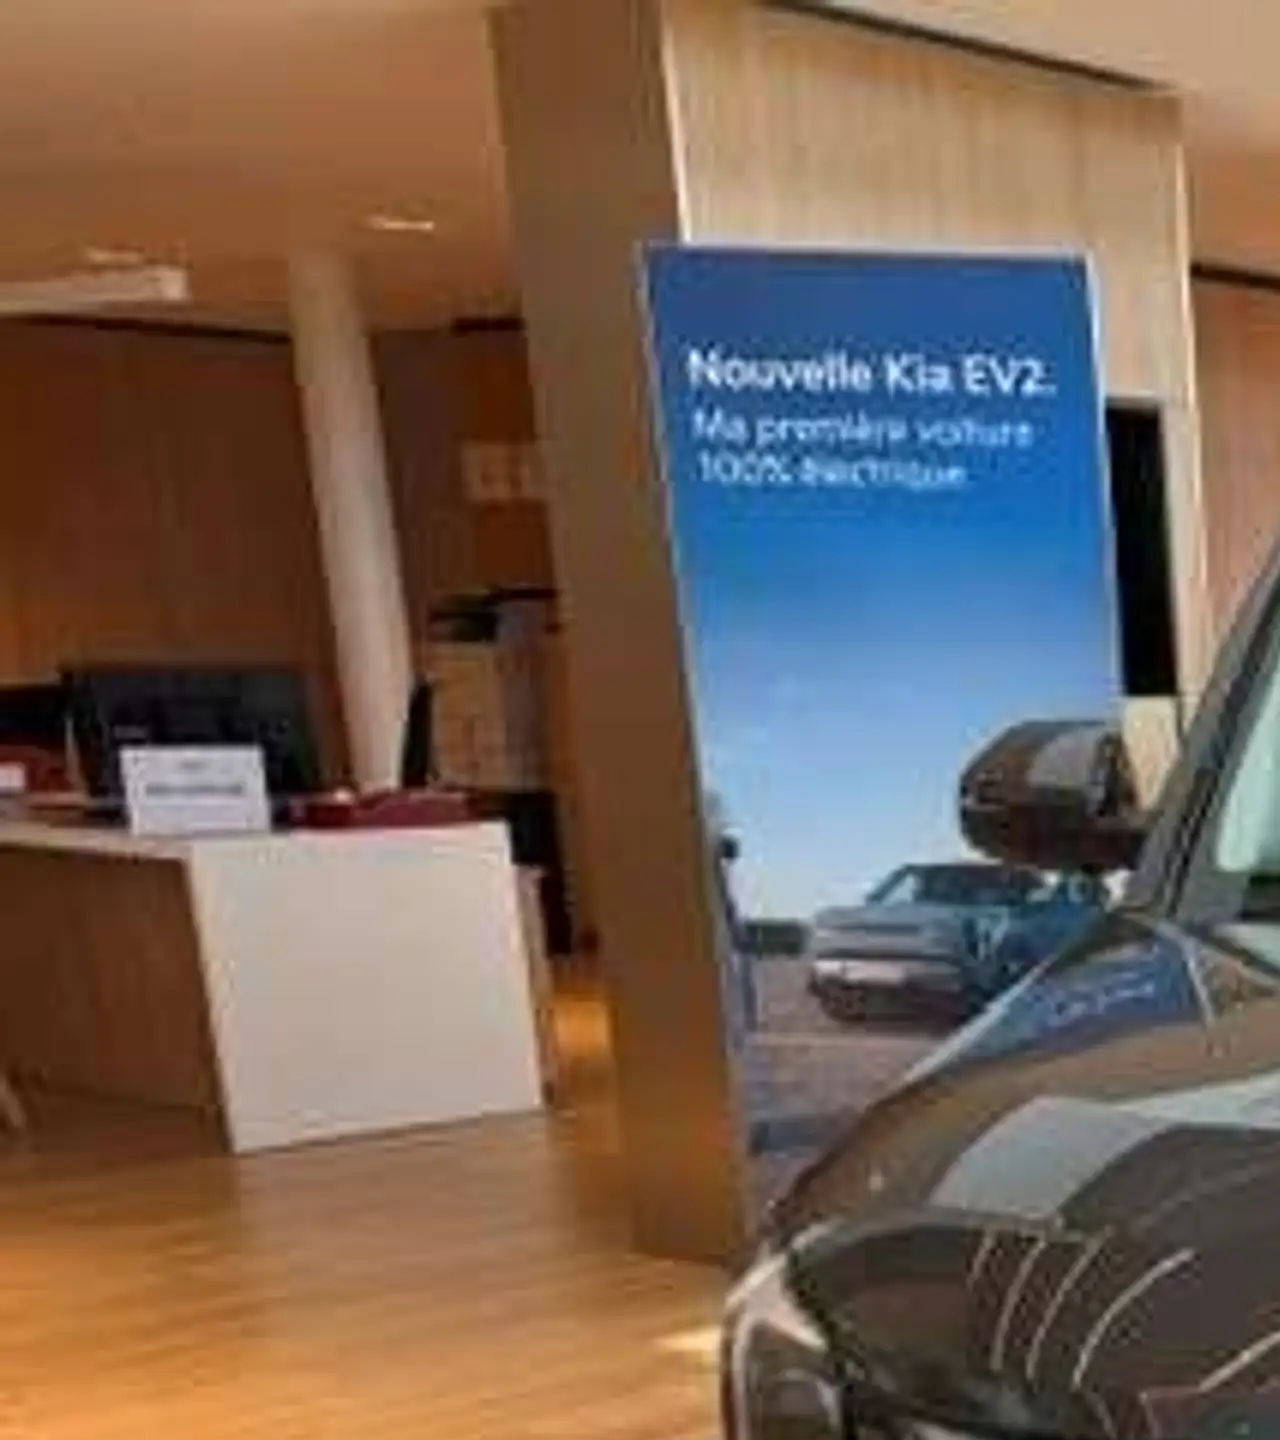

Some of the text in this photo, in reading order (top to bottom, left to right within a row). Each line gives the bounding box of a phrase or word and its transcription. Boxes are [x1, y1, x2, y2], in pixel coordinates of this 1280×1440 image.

[688, 349, 872, 392] Nouvelle
[883, 351, 953, 394] Kia
[691, 407, 747, 447] Ma
